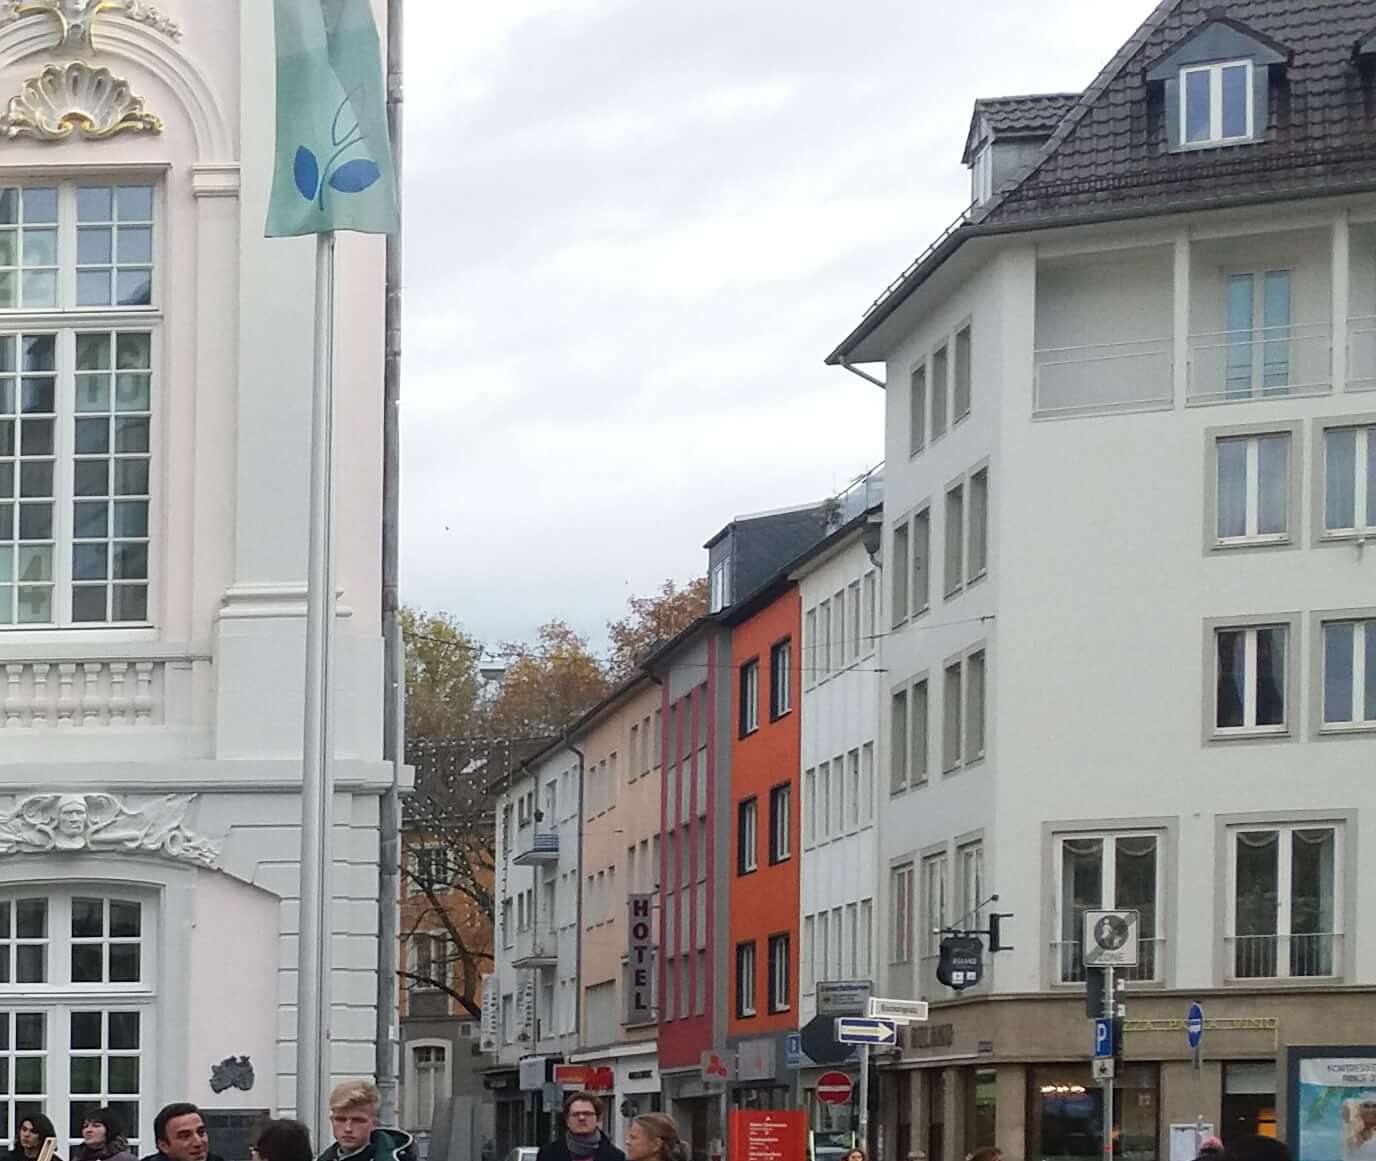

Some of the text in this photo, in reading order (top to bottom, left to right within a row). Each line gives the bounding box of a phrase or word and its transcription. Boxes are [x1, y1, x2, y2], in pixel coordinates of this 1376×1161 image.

[78, 341, 141, 404] 16
[16, 554, 44, 614] 4
[633, 899, 649, 1010] HOTEL
